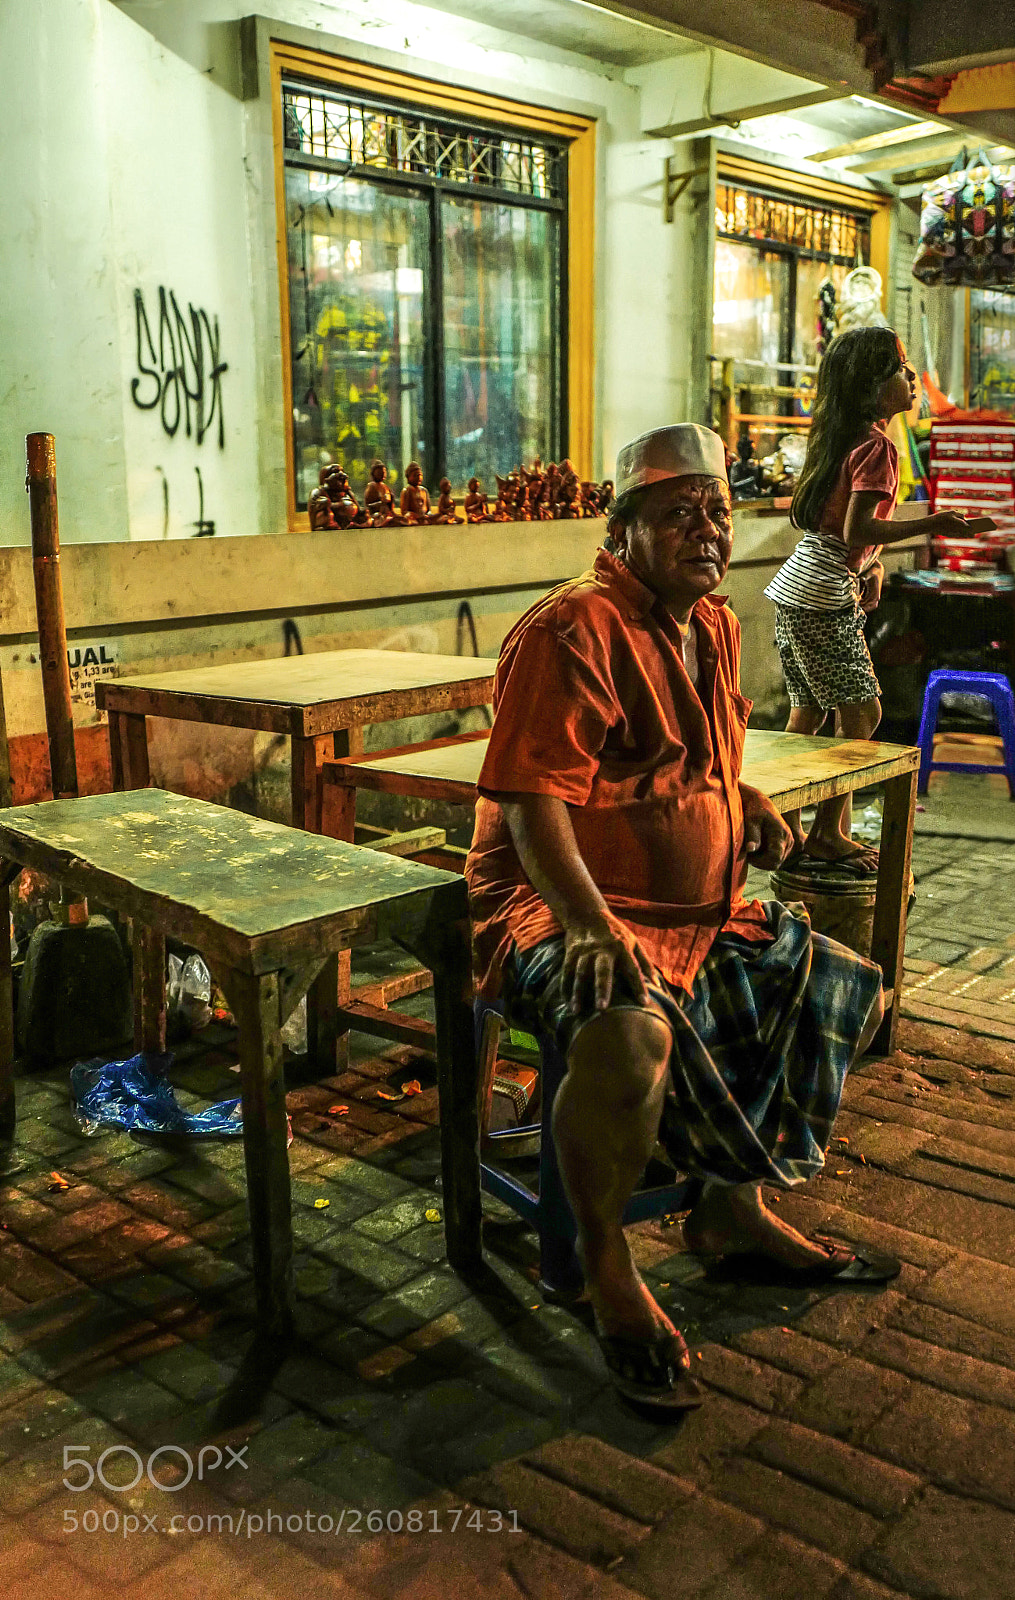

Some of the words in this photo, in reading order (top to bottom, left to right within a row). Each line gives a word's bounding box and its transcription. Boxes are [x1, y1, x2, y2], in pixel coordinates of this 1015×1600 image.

[67, 645, 114, 668] UAL
[84, 666, 100, 677] 1,33
[102, 666, 115, 674] are
